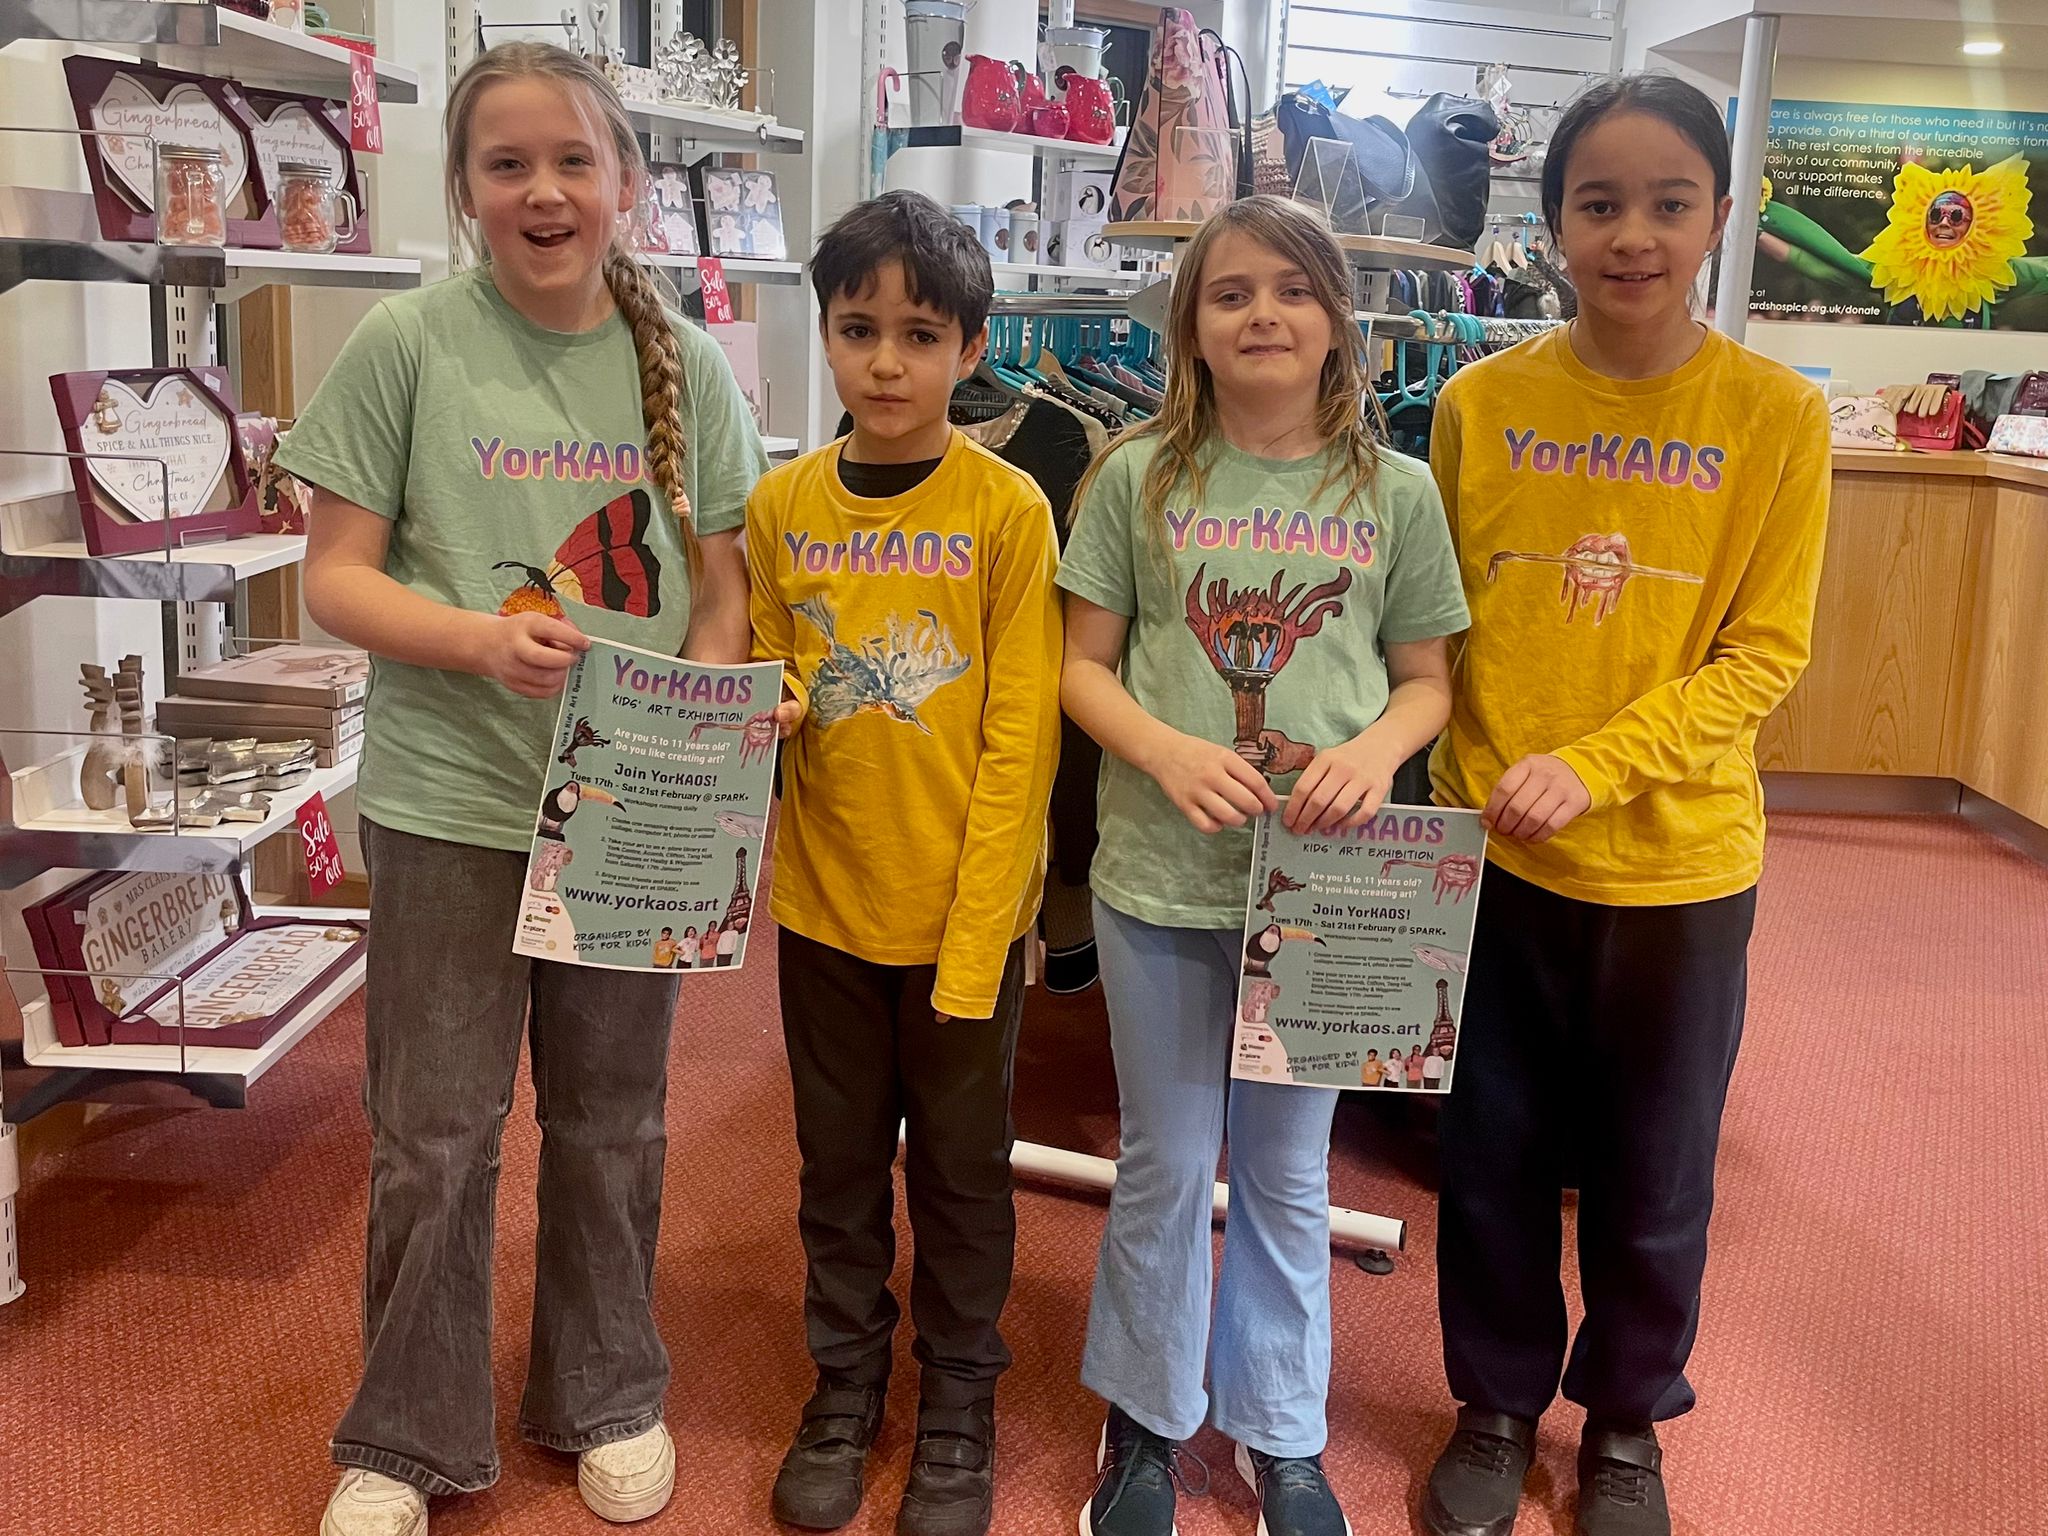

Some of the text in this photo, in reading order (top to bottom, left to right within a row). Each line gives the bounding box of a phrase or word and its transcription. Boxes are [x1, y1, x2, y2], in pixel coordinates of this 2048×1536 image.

[352, 70, 377, 106] Sale
[102, 98, 222, 134] Gingerbread
[353, 109, 372, 129] 50%
[1770, 110, 1790, 120] are
[1793, 108, 1800, 120] is
[1803, 110, 1843, 123] always
[1846, 111, 1869, 123] free
[1871, 112, 1887, 124] for
[1891, 113, 1921, 126] those
[1924, 116, 1950, 127] who
[1952, 118, 1984, 129] need
[1986, 118, 1993, 129] it
[1996, 119, 2017, 130] but
[2018, 120, 2034, 132] it's
[255, 135, 326, 155] ingerbread
[1767, 125, 2048, 147] o provide. Only a third of our funding comes from
[1766, 138, 1984, 160] HS. The rest comes from the incredible
[1796, 154, 1808, 166] of
[1810, 157, 1830, 167] our
[1832, 158, 1900, 172] community.
[1771, 168, 1883, 185] Your support makes
[1786, 185, 1887, 200] all the difference.
[701, 269, 726, 295] Sale
[1755, 289, 1766, 297] at
[705, 295, 722, 310] 50%
[1749, 301, 1881, 316] ardshospice.org.uk/donate
[124, 410, 208, 435] Gingerbread
[96, 434, 216, 452] SPICE & ALL THINGS NICE.
[1504, 427, 1725, 493] YorKAOS
[1164, 506, 1378, 567] YorKAOS
[783, 529, 974, 580] YorKAOS
[613, 654, 753, 705] YorKAOS
[569, 695, 578, 708] Art
[612, 694, 743, 722] KIDS' ART EXHIBITION
[614, 727, 731, 752] Are you 5 to 11 years old?
[615, 741, 726, 765] Do you like creating art?
[614, 762, 718, 787] Join YorKAOS!
[570, 771, 592, 785] Tues
[594, 777, 614, 789] 17th
[621, 782, 637, 794] Sat
[639, 786, 660, 797] 21st
[660, 789, 702, 803] February
[702, 793, 713, 803] @
[302, 811, 330, 858] Sale
[309, 850, 329, 878] 50%
[1303, 843, 1434, 861] KIDS' ART EXHIBITION
[1309, 871, 1423, 888] Are you 5 to 11 years old?
[1311, 883, 1418, 900] Do you like creating art?
[126, 882, 145, 907] MRS
[564, 885, 720, 913] www.yorkaos.art
[86, 873, 226, 973] GINGERBREAD
[1312, 903, 1411, 921] Join YorKAOS!
[573, 928, 651, 942] ORGANISED BY
[1270, 915, 1291, 925] Tues
[1294, 917, 1313, 928] 17th
[1320, 920, 1336, 930] Sat
[1337, 921, 1356, 931] 21st
[1357, 923, 1397, 935] February
[141, 918, 193, 964] BAKERY
[573, 937, 651, 952] KIDS FOR KIDS!
[175, 929, 322, 1026] GINGERBREAD
[251, 958, 304, 996] BAKERY
[1274, 1015, 1422, 1036] www.yorkaos.art
